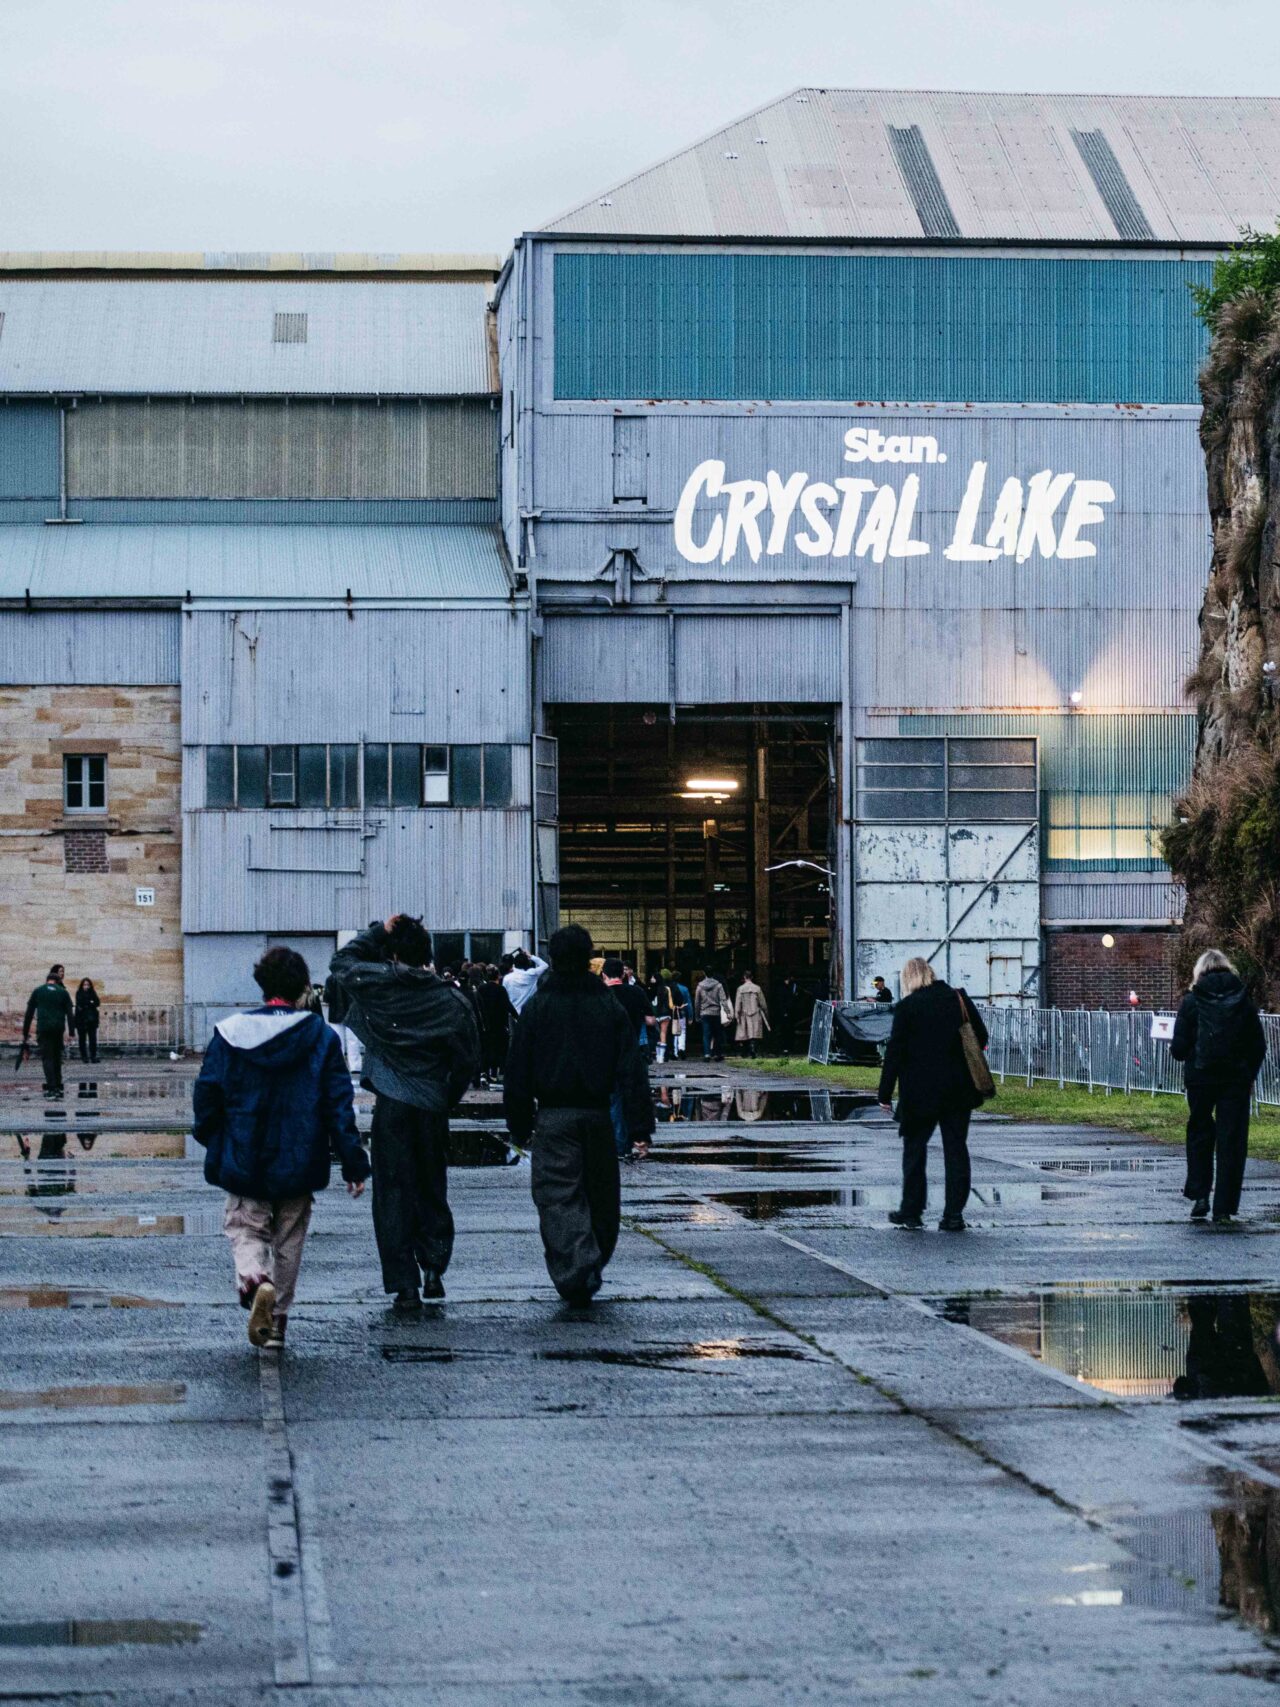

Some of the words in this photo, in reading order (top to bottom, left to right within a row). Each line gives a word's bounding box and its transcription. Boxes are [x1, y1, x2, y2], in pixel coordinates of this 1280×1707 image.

[844, 427, 947, 463] Stan.
[674, 459, 930, 565] CRYSTAL
[943, 461, 1116, 564] LAKE
[138, 895, 152, 903] 151
